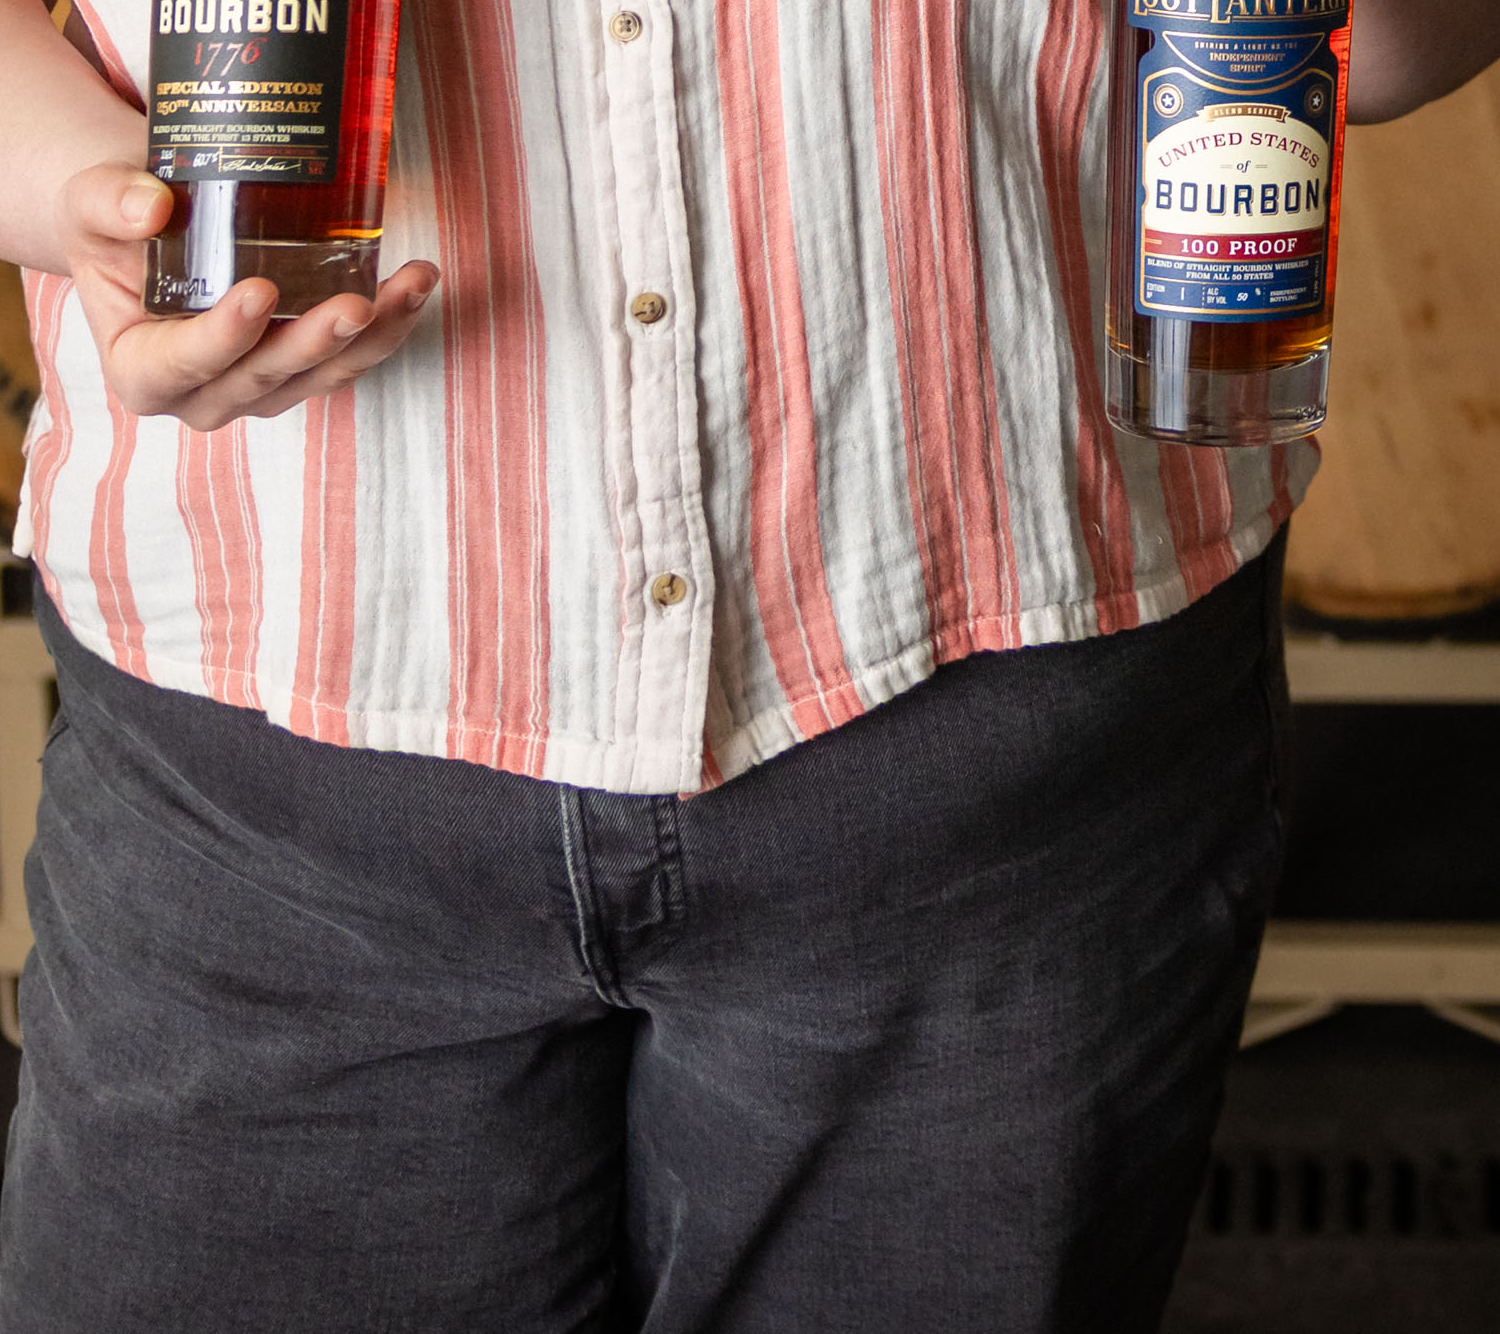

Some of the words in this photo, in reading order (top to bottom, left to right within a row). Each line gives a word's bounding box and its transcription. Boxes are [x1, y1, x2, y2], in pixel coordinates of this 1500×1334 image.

[193, 36, 269, 78] 1776
[1209, 52, 1286, 62] INDEPENDENT
[1229, 63, 1267, 73] SPIRIT
[156, 81, 227, 96] SPECIAL
[228, 80, 324, 95] EDITION
[190, 99, 322, 114] ANNIVERSARY
[1247, 107, 1279, 116] SERIES
[181, 124, 226, 133] STRAIGHT
[227, 124, 275, 133] BOURBON
[277, 125, 326, 134] WHISKIES
[170, 134, 191, 143] FROM
[192, 133, 211, 143] THE
[212, 133, 238, 143] FIRST
[253, 134, 291, 143] STATES
[1157, 132, 1244, 169] UNITED
[1249, 132, 1321, 169] STATES
[1236, 160, 1251, 173] of
[1155, 178, 1321, 217] BOURBON
[1180, 238, 1220, 255] 100
[1229, 237, 1299, 256] PROOF
[1147, 258, 1173, 269] BLEND
[1173, 261, 1186, 270] OF
[1186, 262, 1232, 273] STRAIGHT
[1232, 264, 1274, 274] BOURBON
[1274, 258, 1310, 273] WHISKIES
[1185, 271, 1212, 281] FROM
[1212, 272, 1231, 281] ALL
[1232, 273, 1243, 281] 50
[1243, 272, 1275, 281] STATES
[1207, 286, 1220, 296] ALC
[1236, 292, 1249, 302] 50
